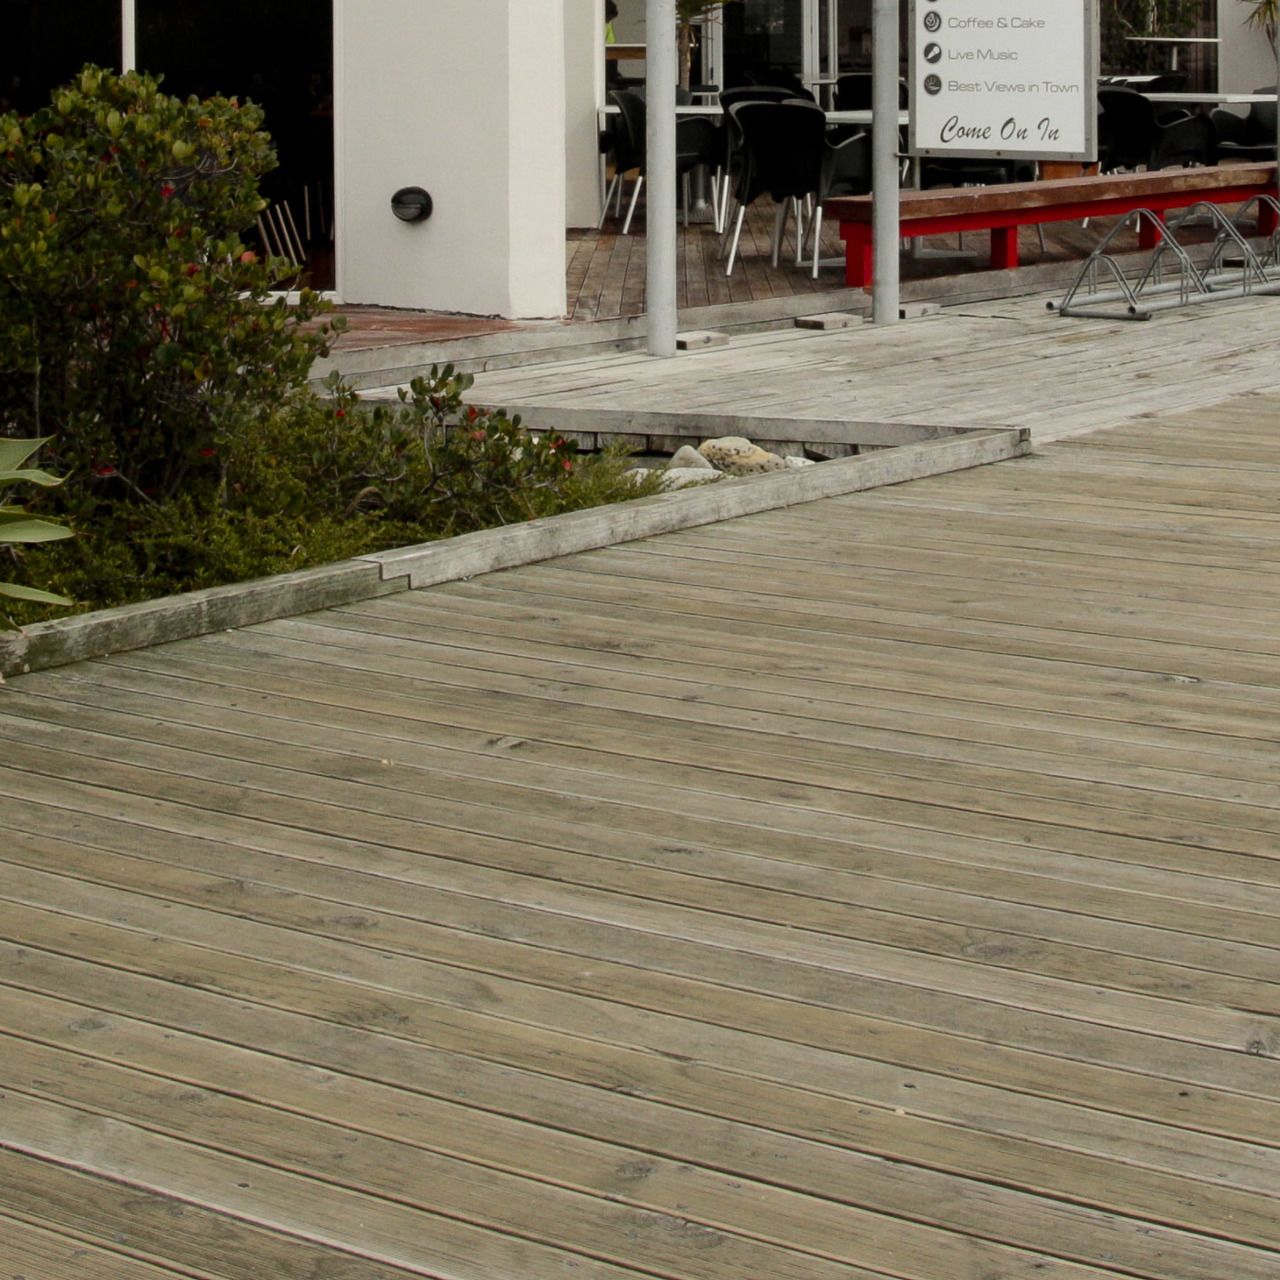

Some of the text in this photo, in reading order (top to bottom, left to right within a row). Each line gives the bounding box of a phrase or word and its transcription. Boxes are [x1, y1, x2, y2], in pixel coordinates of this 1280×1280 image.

[948, 17, 1045, 28] Coffee & Cake
[948, 49, 1018, 60] Live Music
[948, 80, 1079, 93] Best Views in Town
[940, 115, 1060, 143] Come On In
